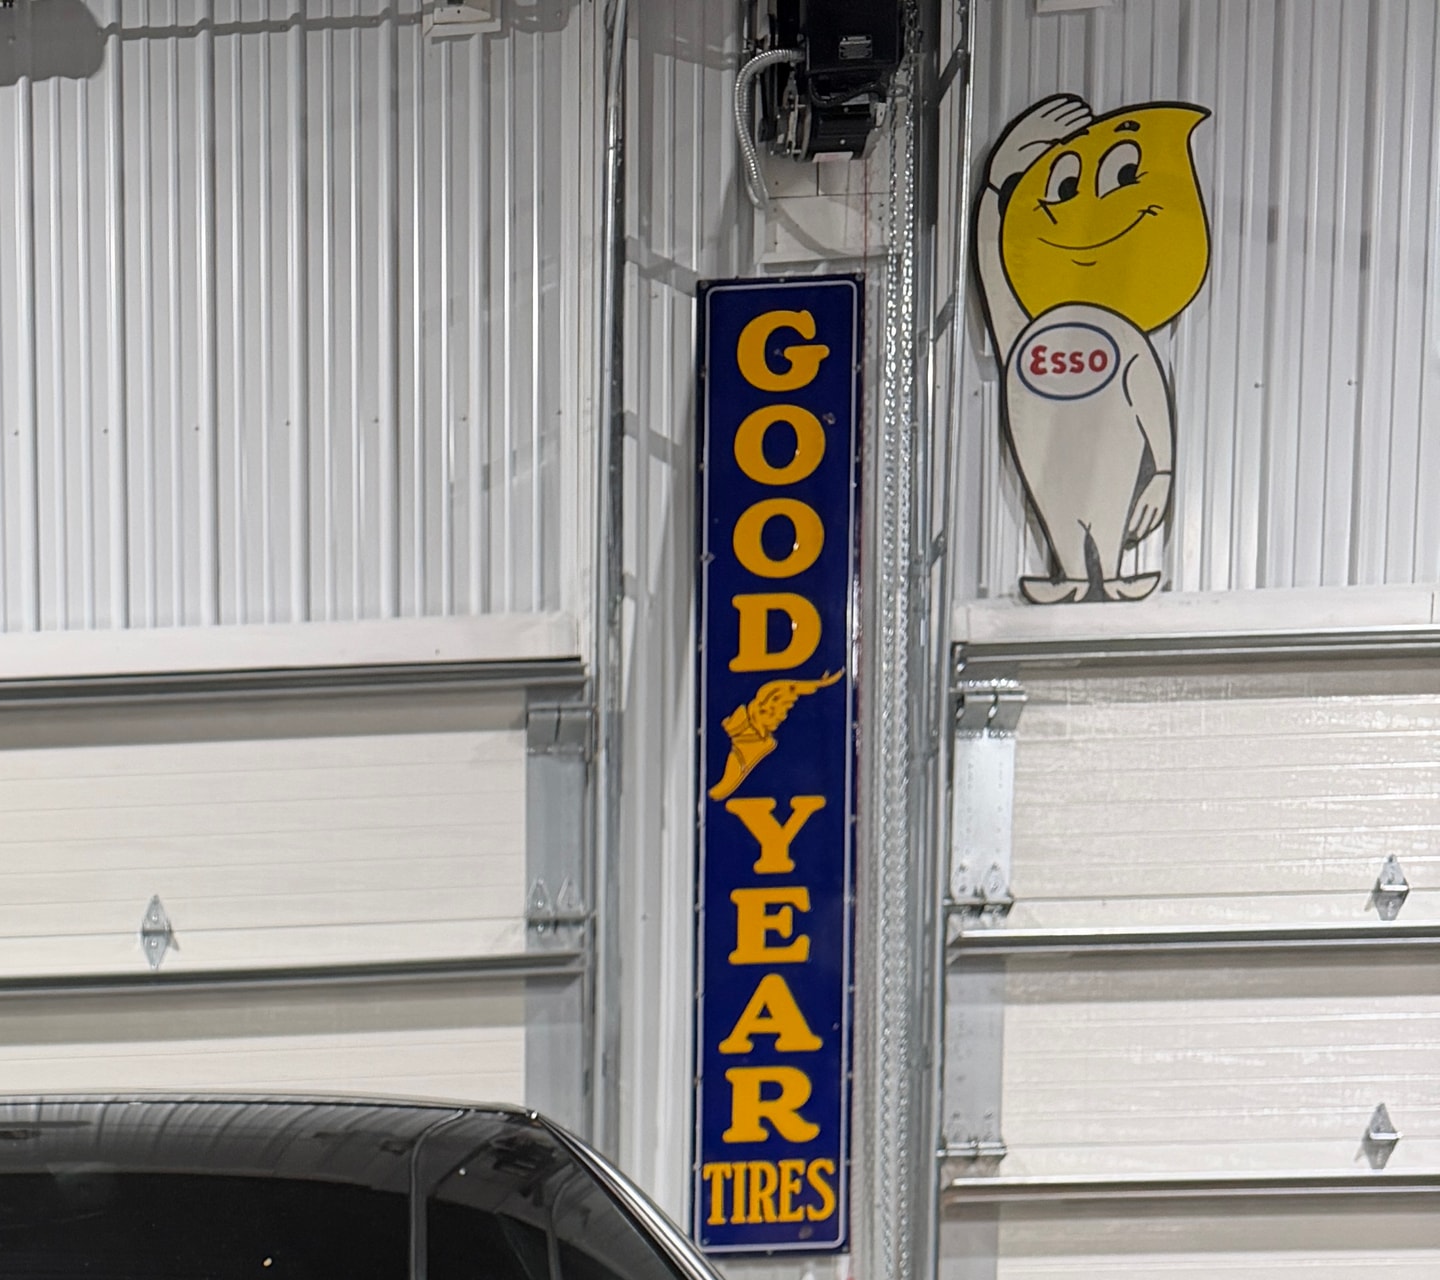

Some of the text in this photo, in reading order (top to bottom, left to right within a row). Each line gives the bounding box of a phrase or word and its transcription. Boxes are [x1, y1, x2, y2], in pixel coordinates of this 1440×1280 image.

[718, 309, 830, 1143] GOOD YEAR
[702, 1157, 836, 1225] TIRES
